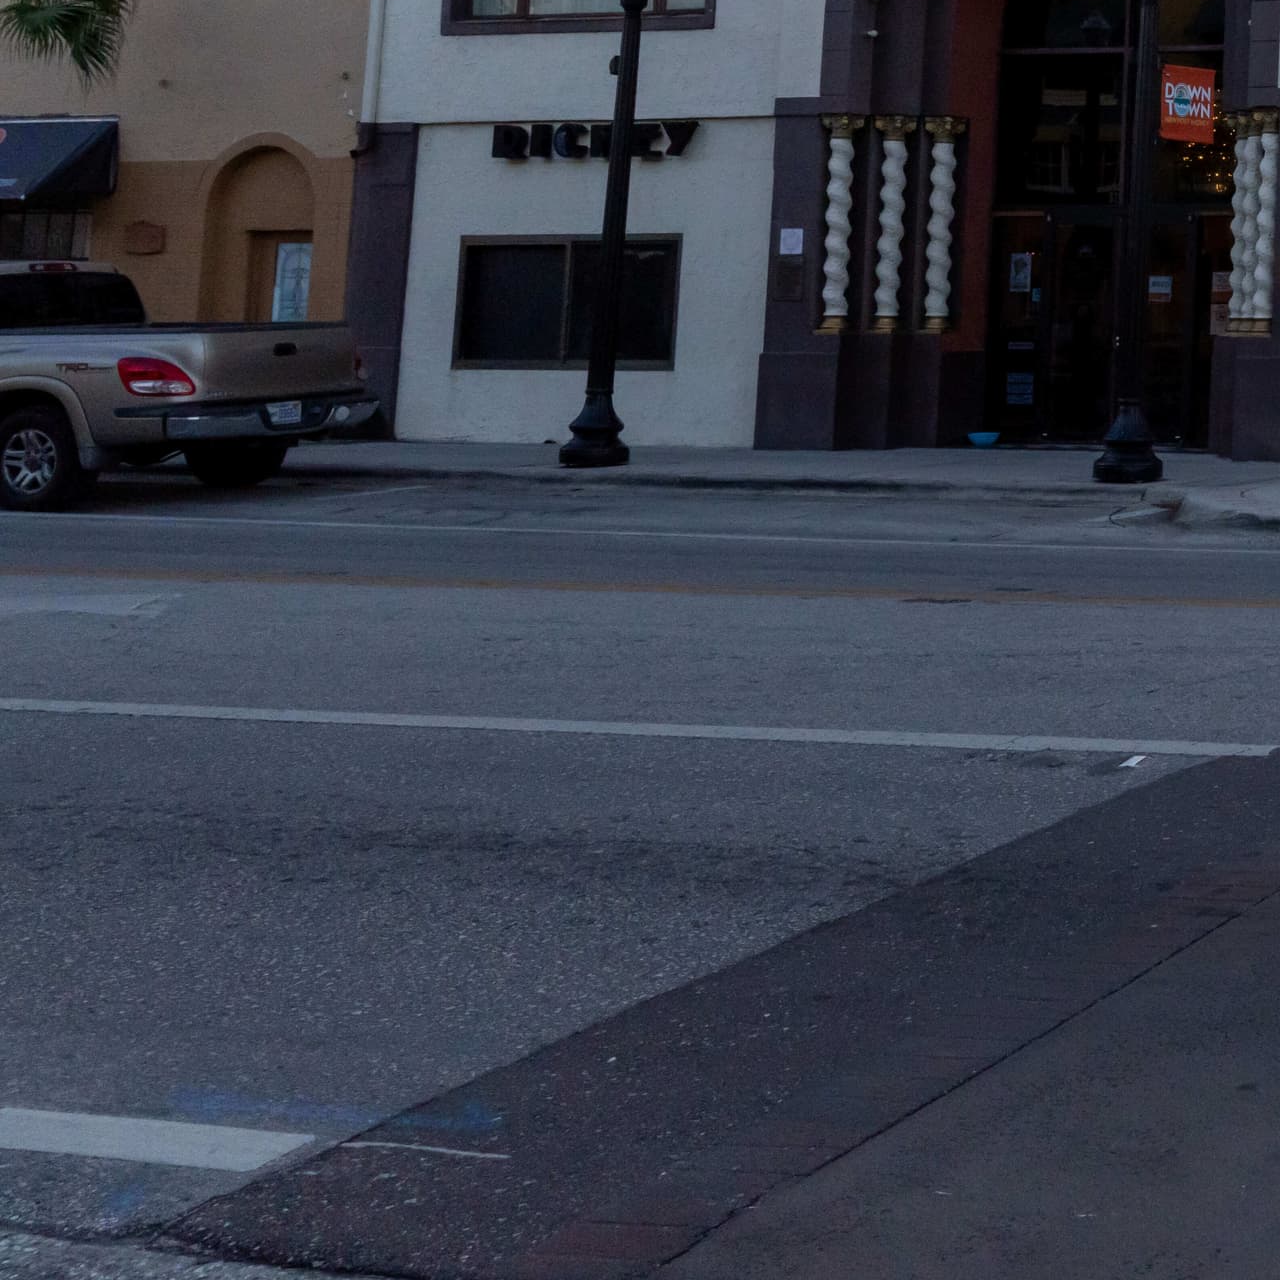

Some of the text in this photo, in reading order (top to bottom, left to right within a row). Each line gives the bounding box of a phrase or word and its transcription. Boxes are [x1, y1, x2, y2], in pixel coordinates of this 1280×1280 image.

[1165, 82, 1211, 103] DOWN
[1165, 99, 1211, 119] TOWN
[56, 363, 89, 373] TRD
